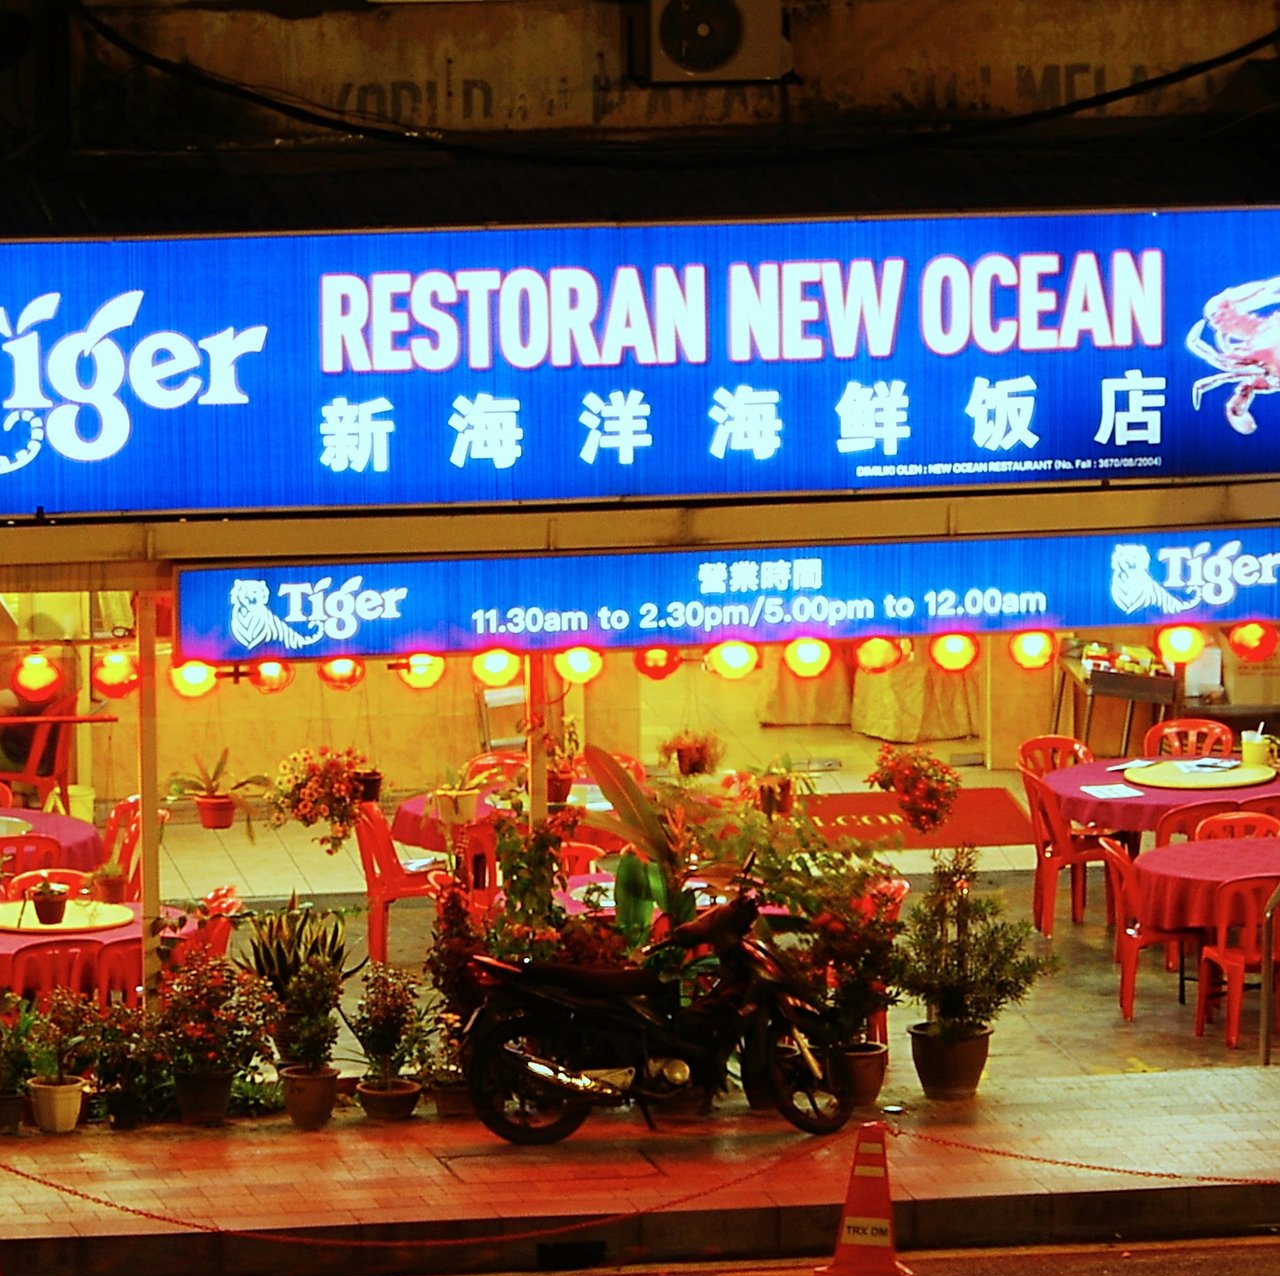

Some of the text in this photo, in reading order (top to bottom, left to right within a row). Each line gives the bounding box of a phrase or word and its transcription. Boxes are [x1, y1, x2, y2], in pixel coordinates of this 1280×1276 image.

[320, 247, 1164, 373] RESTORAN NEW OCEAN
[319, 368, 1167, 473] 新海洋海鲜饭店
[928, 463, 953, 475] NEW
[953, 461, 988, 474] OCEAN
[988, 459, 1054, 473] RESTAURANT
[697, 558, 823, 595] 營業時間
[277, 576, 408, 640] Tiger
[471, 587, 1047, 634] 11.30am to 2.30pm/5.00pm to 12.00am
